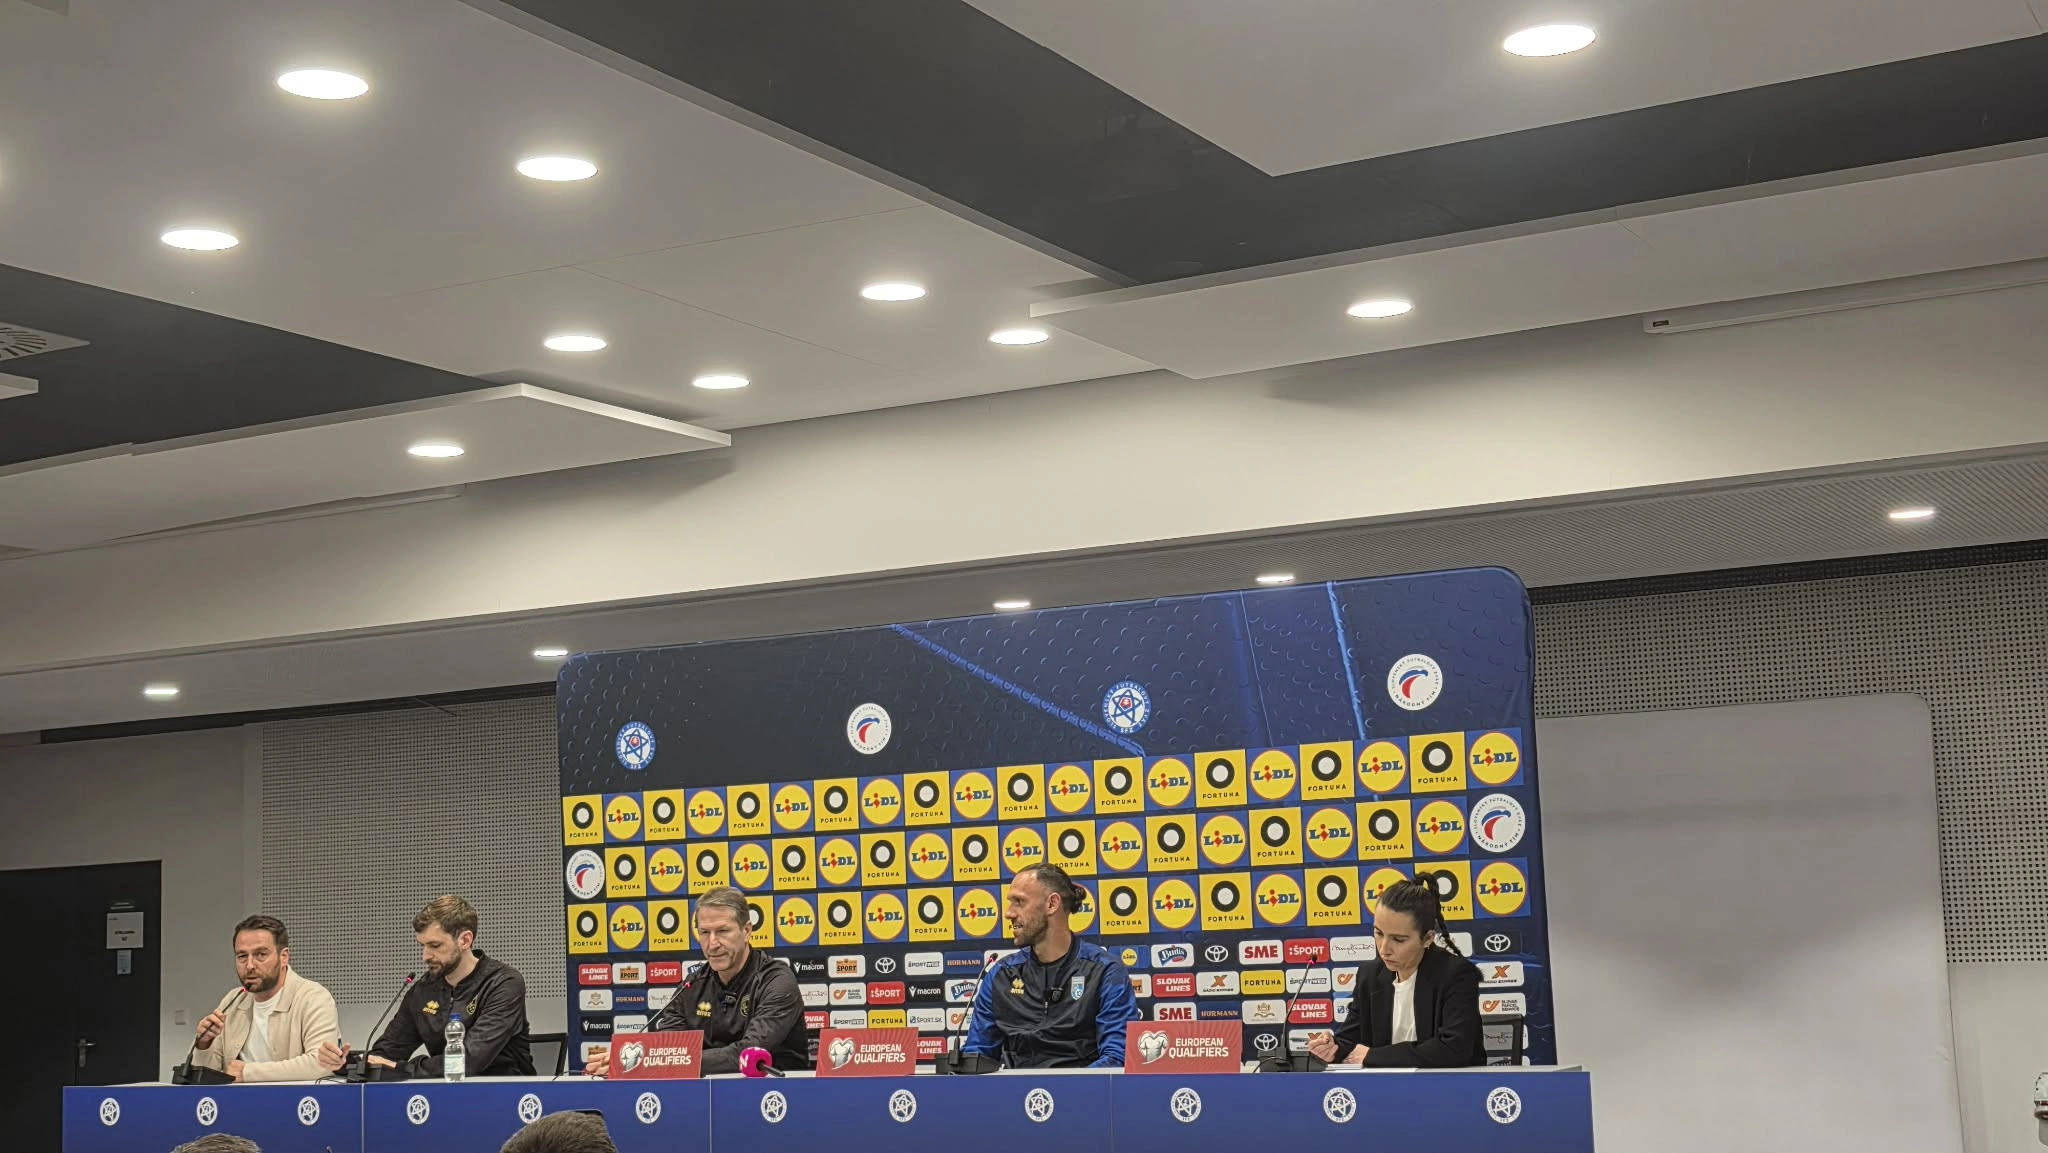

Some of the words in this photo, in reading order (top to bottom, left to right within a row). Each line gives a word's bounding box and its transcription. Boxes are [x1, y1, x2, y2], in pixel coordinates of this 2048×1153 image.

[1418, 776, 1458, 784] FORTUNA
[1203, 791, 1239, 799] FORTUNA
[1102, 798, 1137, 806] FORTUNA
[1005, 804, 1038, 812] FORTUNA
[570, 831, 597, 839] FORTUNA
[1258, 850, 1295, 858] FORTUNA
[1154, 855, 1190, 863] FORTUNA
[1314, 910, 1352, 918] FORTUNA
[1244, 945, 1278, 958] SME
[802, 962, 824, 970] macron
[1160, 1007, 1192, 1020] SME
[1175, 1038, 1223, 1046] EUROPEAN
[650, 1047, 687, 1055] EUROPEAN
[861, 1044, 901, 1052] EUROPEAN
[1169, 1048, 1228, 1058] QUALIFIERS
[643, 1056, 691, 1067] QUALIFIERS
[854, 1053, 906, 1064] QUALIFIERS
